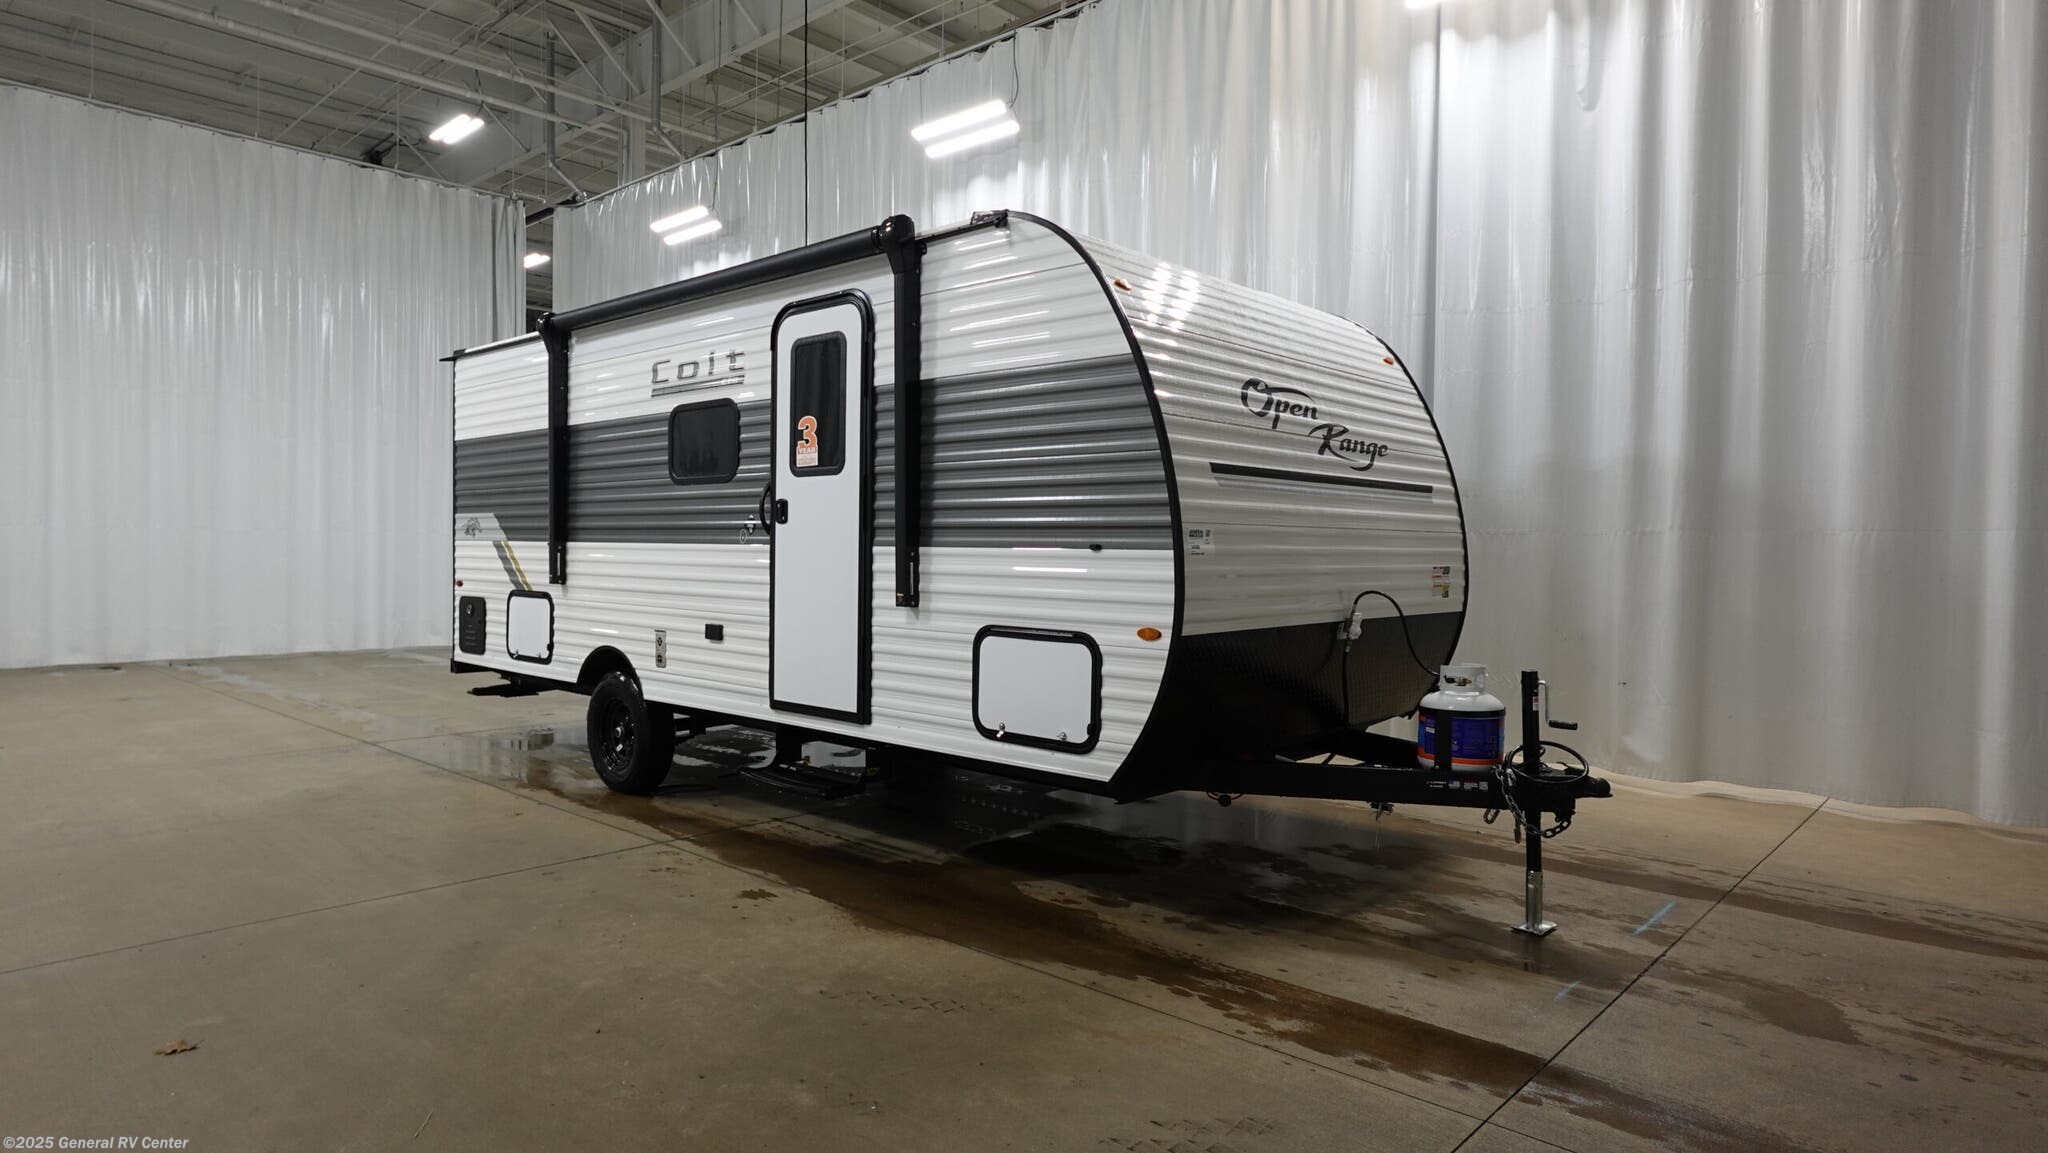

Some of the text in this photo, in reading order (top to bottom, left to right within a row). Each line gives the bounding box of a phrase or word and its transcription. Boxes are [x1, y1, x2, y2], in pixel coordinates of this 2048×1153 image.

[651, 350, 745, 384] Colt
[1240, 378, 1319, 430] Open
[798, 415, 818, 448] 3
[1308, 423, 1389, 472] Range
[798, 446, 816, 454] YEAR
